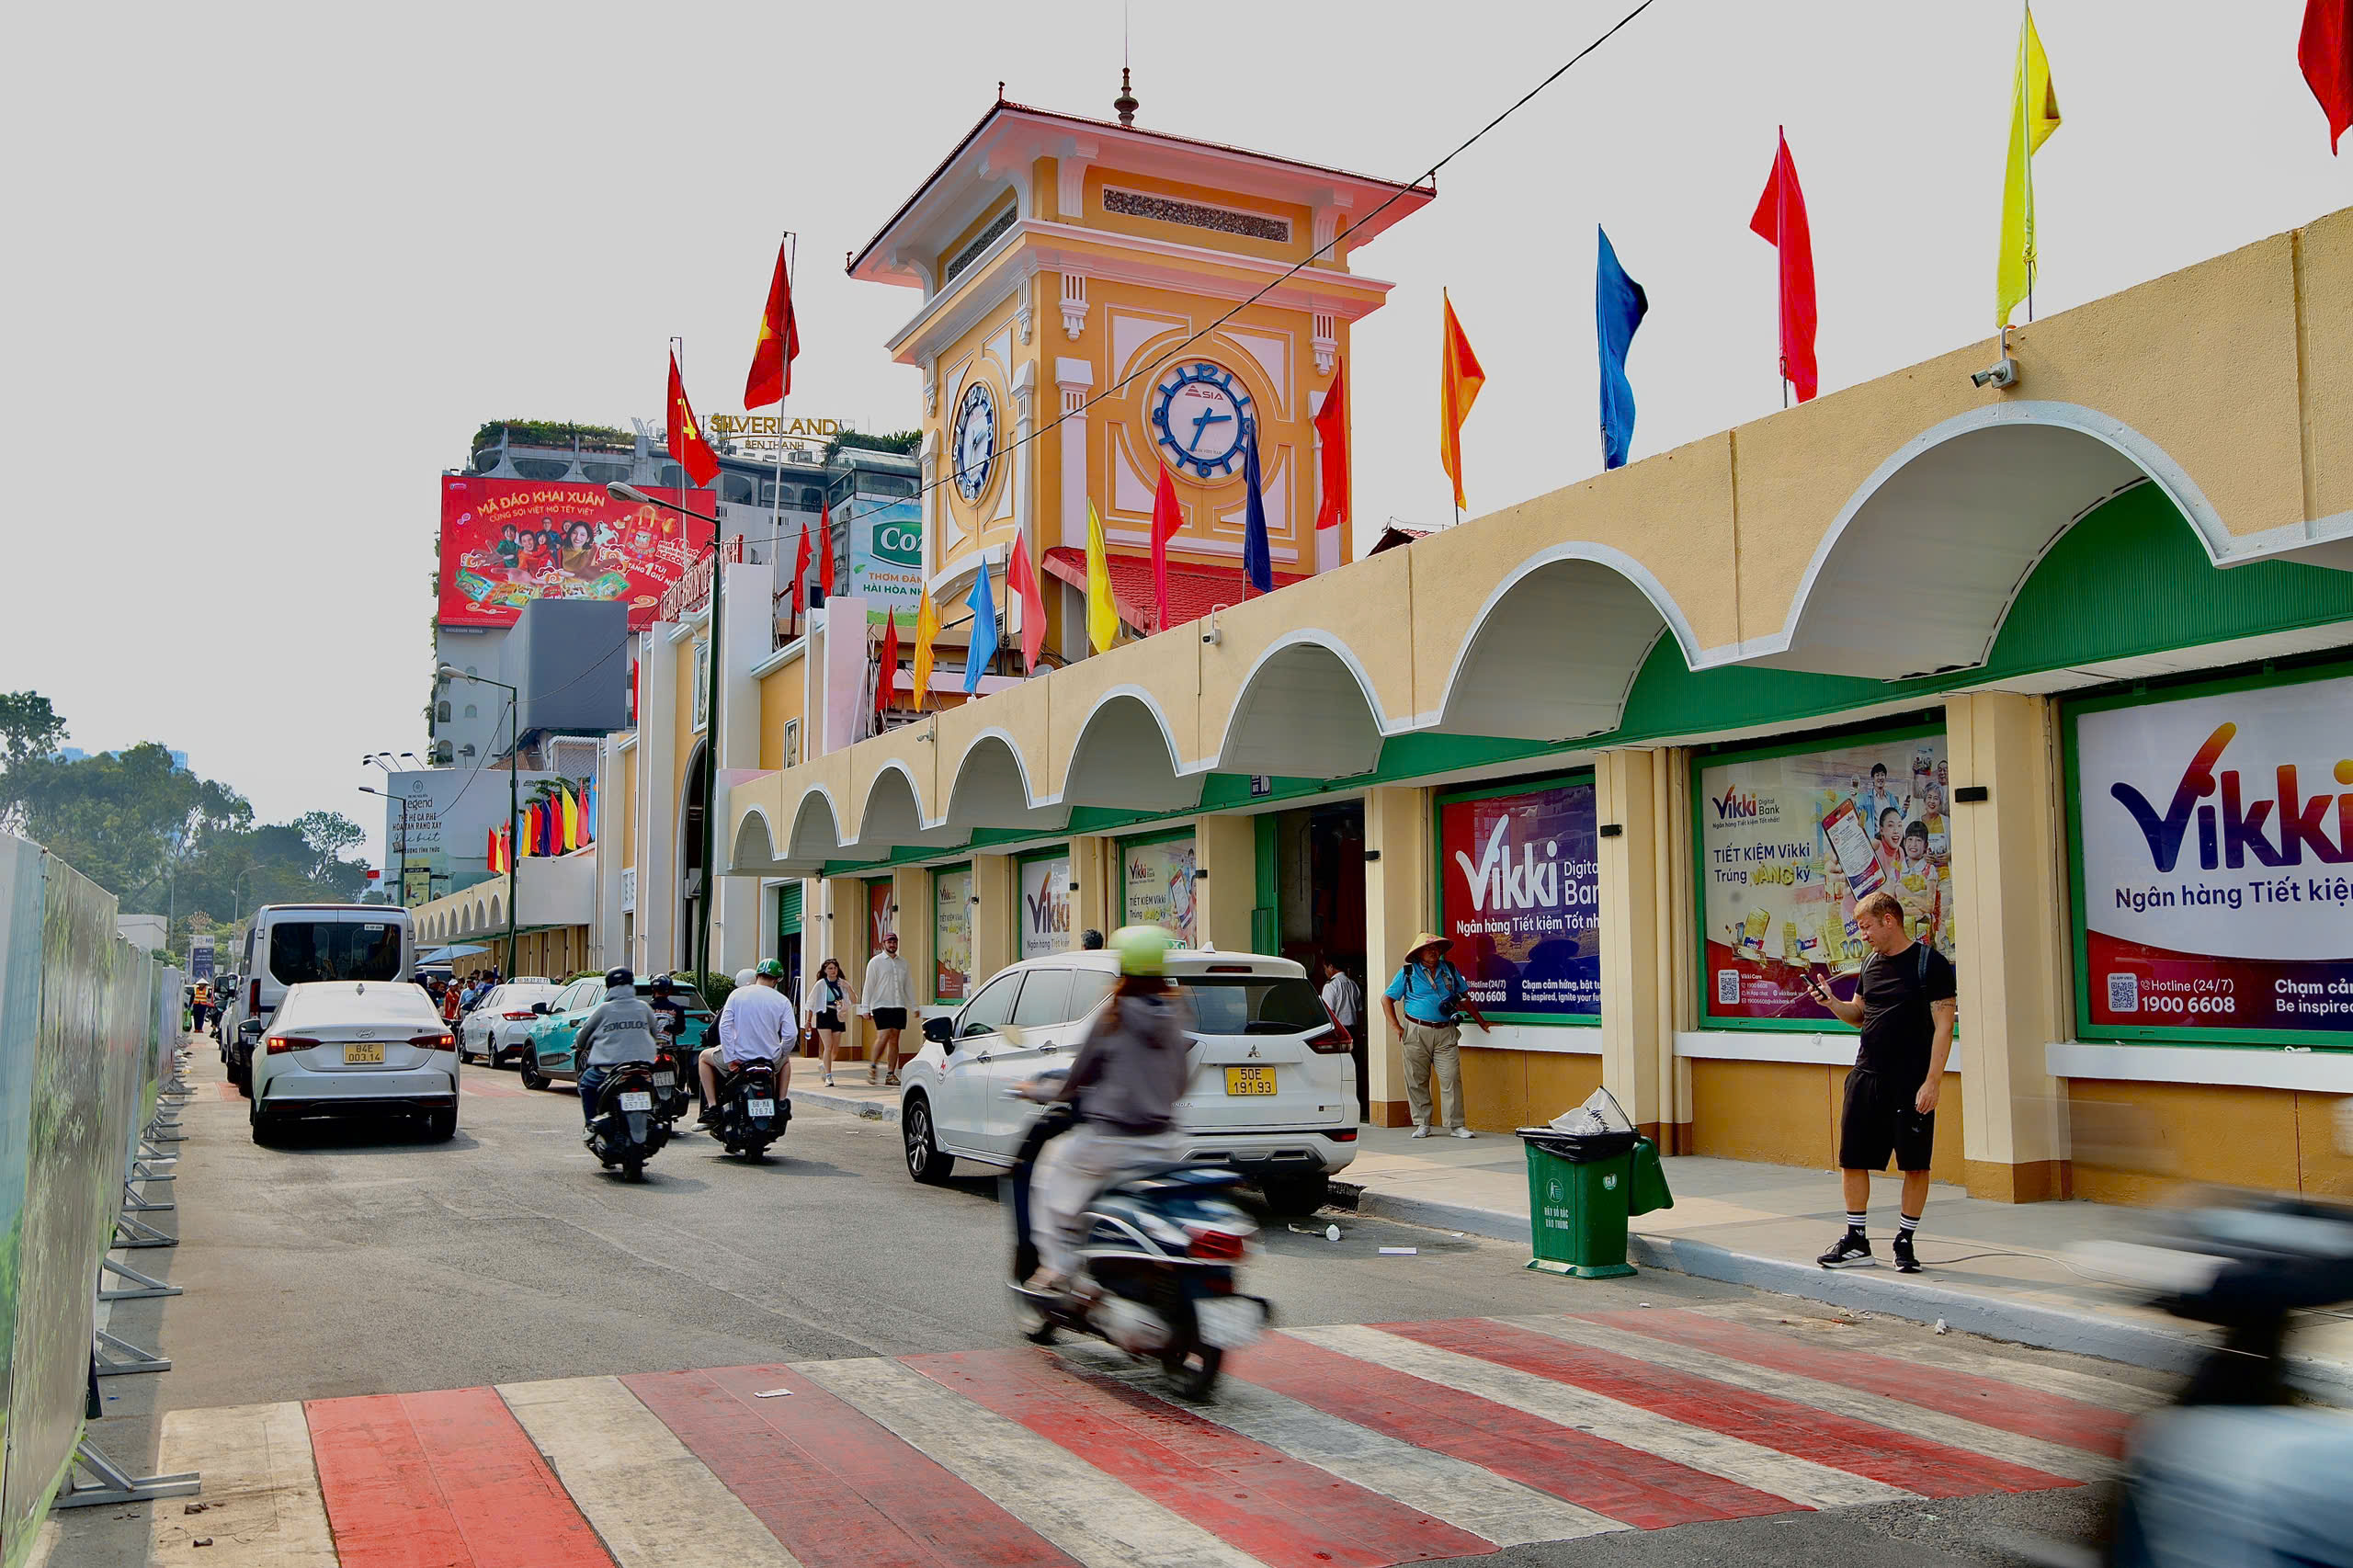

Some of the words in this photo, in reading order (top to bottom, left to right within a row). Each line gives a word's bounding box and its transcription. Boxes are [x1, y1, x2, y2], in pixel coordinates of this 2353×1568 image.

[1196, 363, 1218, 381] 12
[1186, 385, 1223, 400] ASIA
[1152, 407, 1165, 426] 9
[710, 415, 838, 435] SILVERLAND
[1197, 460, 1212, 478] 6
[477, 498, 499, 517] MÃ
[500, 492, 529, 508] ĐÁO
[533, 491, 564, 503] KHAI
[567, 491, 605, 507] XUÂN
[645, 562, 654, 576] 1
[869, 572, 899, 582] THƠM
[863, 583, 881, 593] HÀI
[884, 584, 907, 595] HÒA
[1712, 784, 1756, 820] Vikki
[1758, 798, 1775, 806] Digital
[2110, 722, 2353, 872] Vikki
[1758, 805, 1779, 815] Bank
[1713, 842, 1741, 863] TIẾT
[1744, 842, 1774, 864] KIỆM
[1778, 842, 1810, 858] Vikki
[1456, 814, 1558, 911] Vikki
[1714, 868, 1747, 884] Trúng
[1796, 866, 1811, 882] ký
[1028, 871, 1070, 934] Vikki
[1130, 893, 1140, 906] TIẾT
[1154, 894, 1166, 904] Vikki
[2115, 886, 2176, 913] Ngân
[2182, 883, 2242, 909] hàng
[2249, 876, 2301, 903] Tiết
[2309, 877, 2353, 907] kiệ
[1457, 920, 1483, 937] Ngân
[1485, 919, 1510, 935] hàng
[1512, 915, 1533, 931] Tiết
[1537, 916, 1562, 934] kiệm
[1564, 911, 1584, 929] Tốt
[1840, 938, 1863, 959] 10
[1471, 980, 1488, 988] Hotline
[1489, 980, 1506, 990] (24/7)
[1522, 980, 1542, 992] Chạm
[1543, 979, 1558, 989] cảm
[1559, 979, 1579, 991] hứng,
[1580, 979, 1593, 992] bật
[2151, 979, 2191, 992] Hotline
[2193, 978, 2234, 994] (24/7)
[2275, 979, 2324, 998] Chạm
[2327, 978, 2353, 994] cả
[1486, 991, 1506, 1002] 6608
[1522, 993, 1530, 1001] Be
[1531, 993, 1557, 1003] inspired,
[1558, 993, 1576, 1003] ignite
[1576, 994, 1591, 1003] your
[1592, 993, 1600, 1002] fu
[2142, 996, 2184, 1012] 1900
[2188, 996, 2235, 1012] 6608
[2276, 999, 2295, 1012] Be
[348, 1053, 381, 1062] 003.14
[1241, 1069, 1262, 1080] 50E
[1234, 1082, 1271, 1093] 191.93
